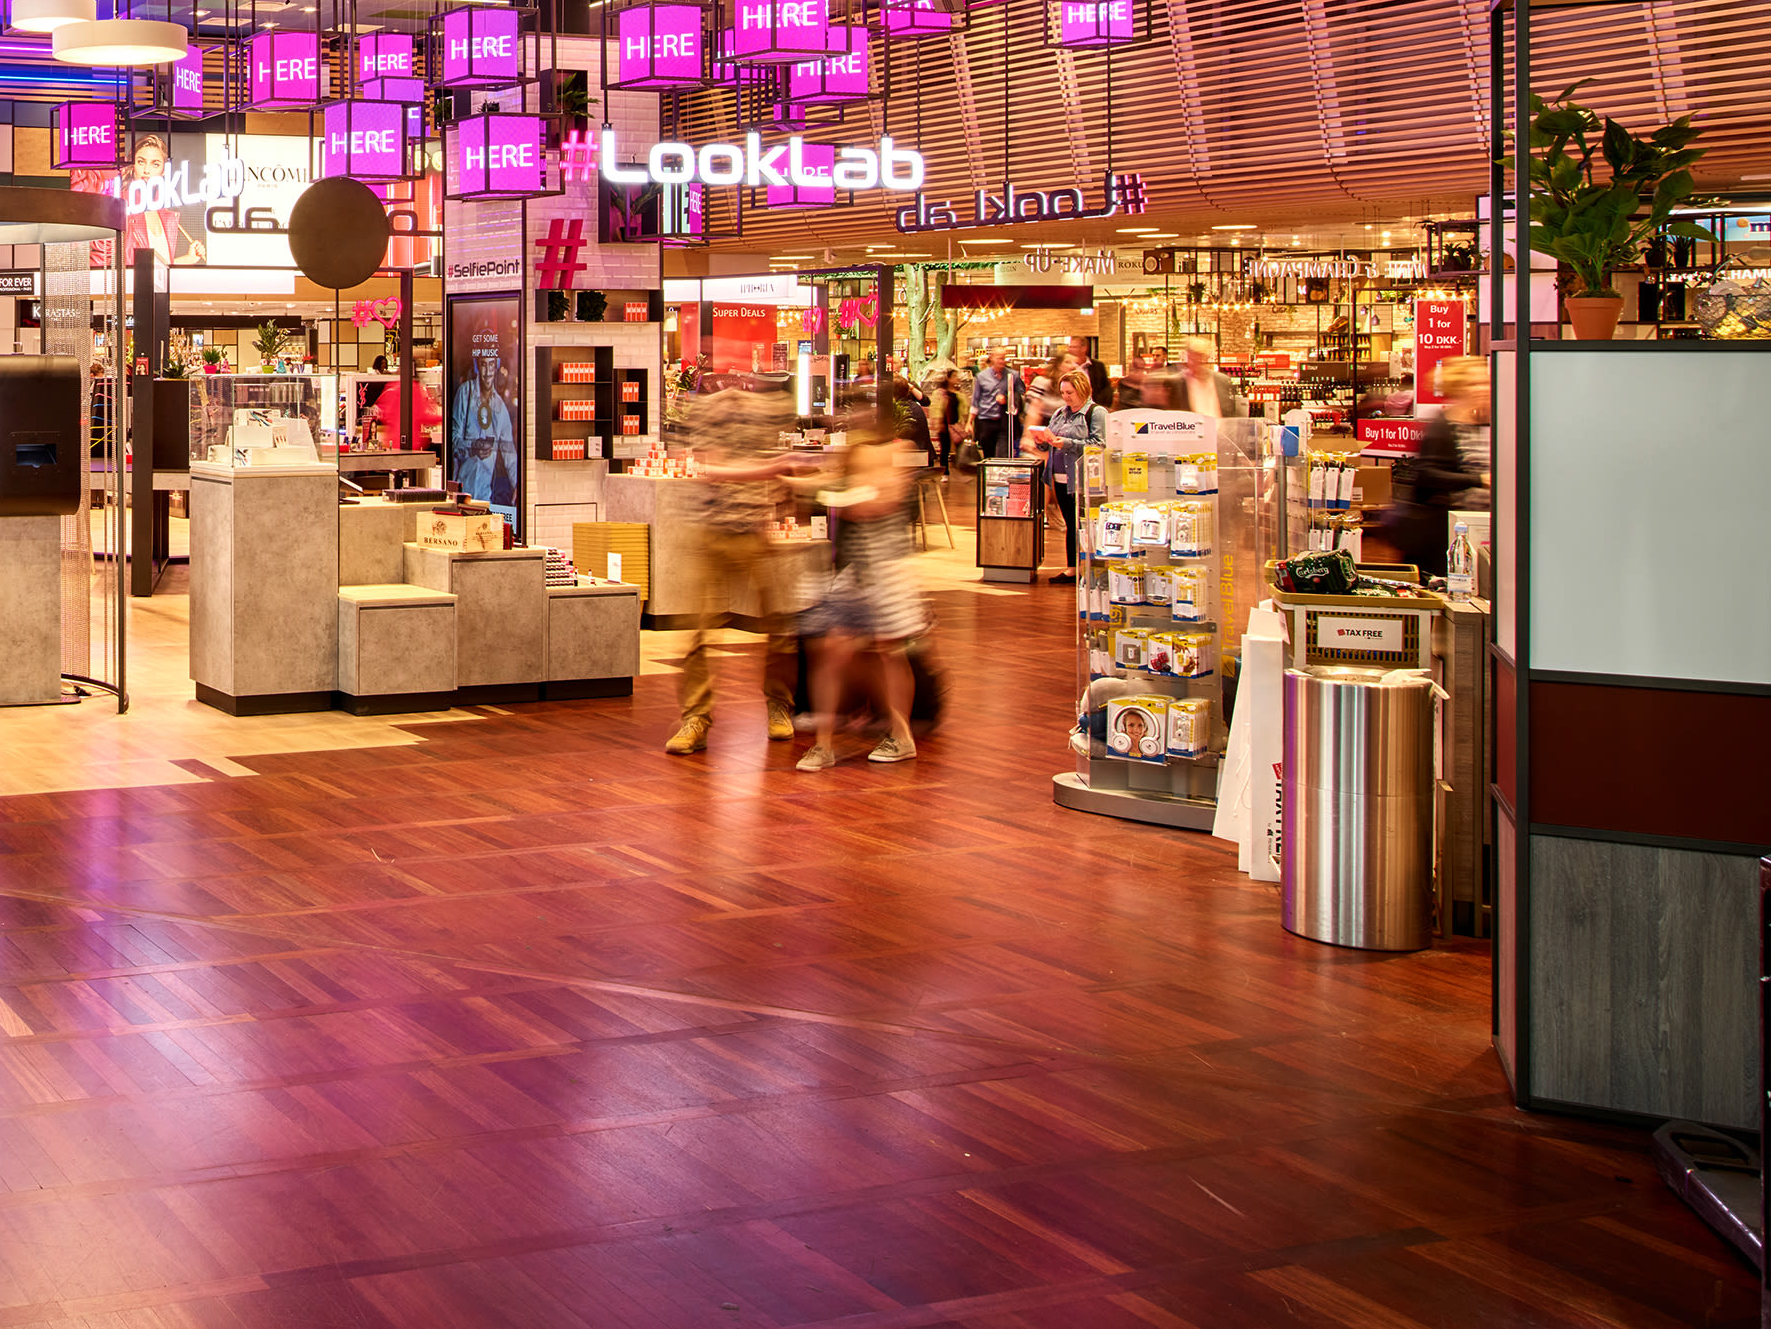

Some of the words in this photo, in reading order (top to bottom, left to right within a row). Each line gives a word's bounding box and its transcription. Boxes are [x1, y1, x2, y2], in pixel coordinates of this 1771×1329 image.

[741, 1, 819, 30] HERE
[1067, 0, 1128, 24] HERE
[450, 35, 513, 60] HERE
[626, 32, 695, 60] HERE
[259, 57, 317, 83] HERE
[363, 53, 409, 73] HERE
[797, 52, 863, 77] HERE
[176, 67, 201, 94] HERE
[64, 124, 112, 146] HERE
[331, 129, 396, 155] HERE
[465, 143, 533, 170] HERE
[559, 128, 925, 190] #LookLab
[447, 259, 520, 279] #SelfiePoint
[14, 277, 32, 287] EVER
[1430, 304, 1449, 315] Buy
[1428, 317, 1434, 328] 1
[1437, 319, 1451, 328] for
[472, 335, 484, 344] GET
[485, 334, 498, 344] SOME
[1418, 333, 1434, 344] 10
[472, 350, 482, 358] HIP
[482, 349, 498, 358] MUSIC
[1365, 427, 1379, 441] Buy
[1385, 428, 1396, 440] for
[1397, 426, 1409, 440] 10
[423, 536, 458, 547] BERSANO
[1295, 566, 1330, 579] Carlsberg
[1345, 628, 1362, 637] TAX
[1362, 629, 1383, 638] FREE
